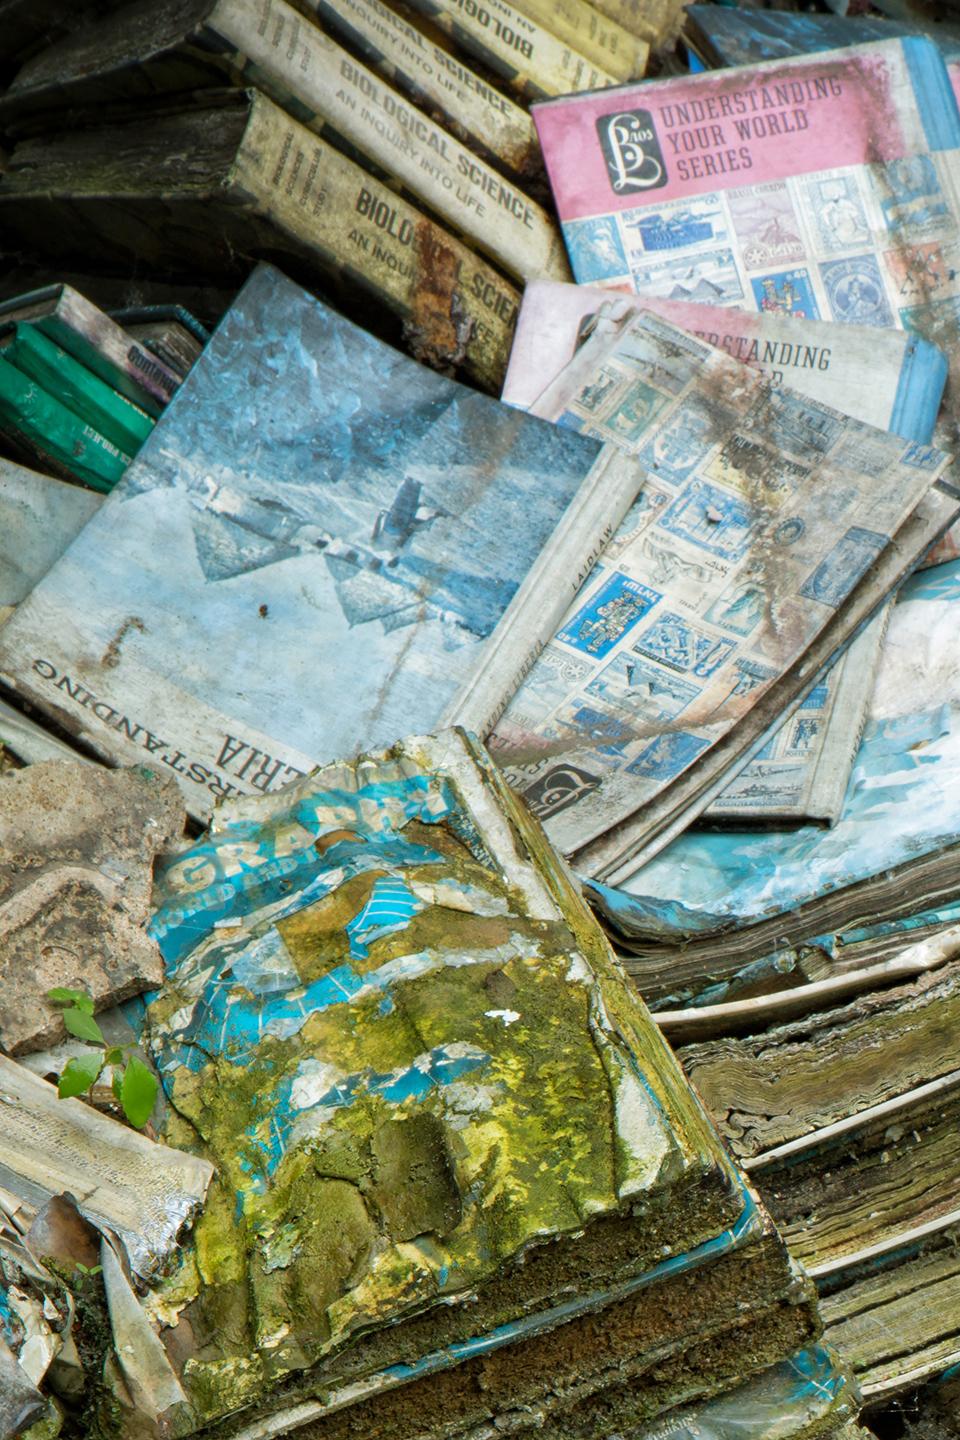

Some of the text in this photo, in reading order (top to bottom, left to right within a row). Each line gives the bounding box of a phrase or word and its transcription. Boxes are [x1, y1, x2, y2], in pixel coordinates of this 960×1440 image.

[454, 0, 535, 60] BIOLOGI
[400, 45, 433, 75] INTO
[436, 73, 469, 102] LIFE
[433, 48, 513, 121] SCIENCE
[660, 75, 844, 130] UNDERSTANDING
[336, 89, 487, 218] AN INQUIRY INTO LIFE
[340, 60, 451, 163] BIOLOGICAL
[456, 153, 534, 231] SCIENCE
[667, 108, 811, 156] YOUR WORLD
[676, 149, 754, 182] SERIES
[348, 229, 370, 251] AN
[571, 523, 614, 592] LAIDLAW
